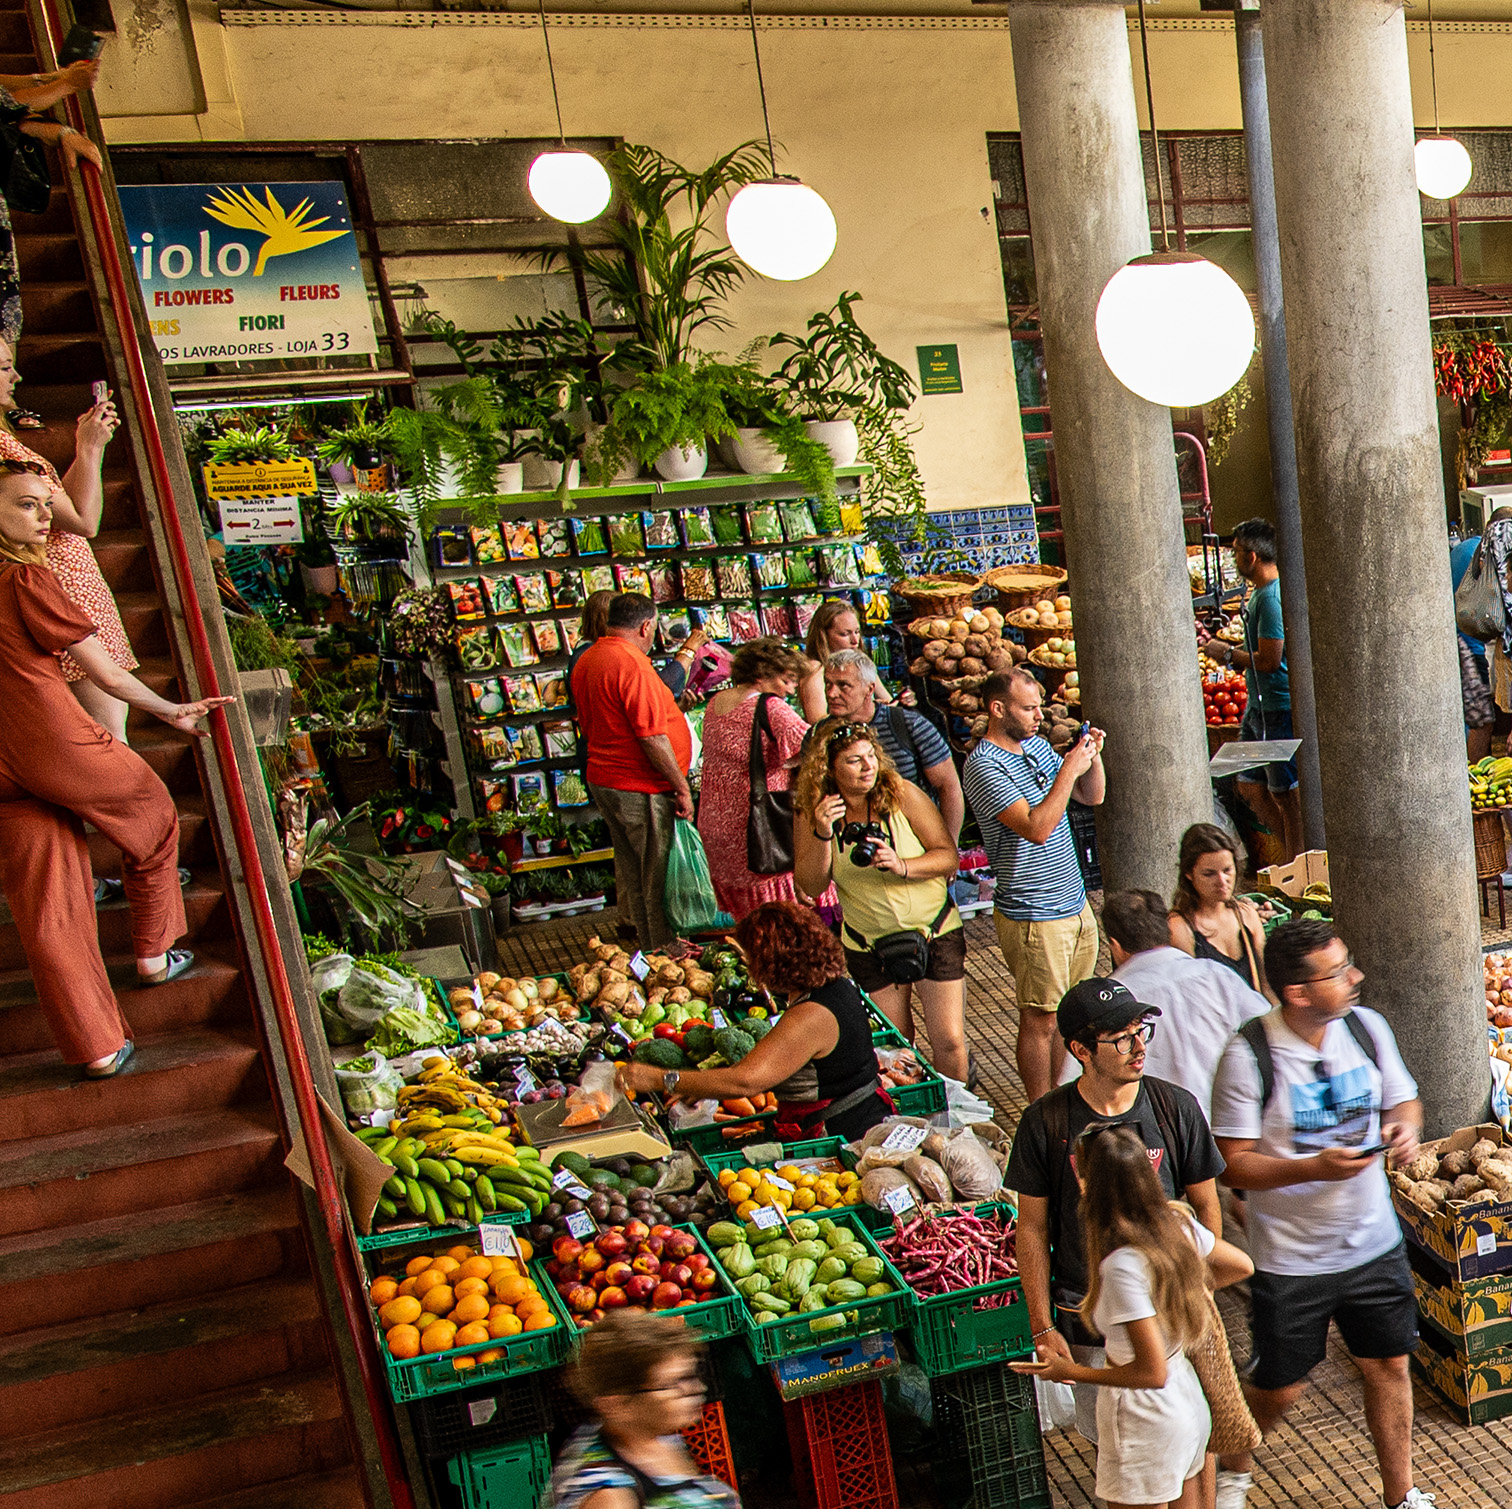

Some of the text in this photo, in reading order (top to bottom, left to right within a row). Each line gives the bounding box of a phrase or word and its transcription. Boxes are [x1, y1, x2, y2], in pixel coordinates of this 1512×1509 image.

[130, 230, 250, 280] iolo
[154, 284, 341, 307] FLOWERS FLEURS
[239, 315, 286, 331] FIORI
[183, 342, 274, 358] LAVRADORES
[287, 340, 318, 353] LOJA
[321, 332, 350, 351] 33
[212, 484, 251, 493] AGUARDE
[252, 483, 272, 491] AQUI
[280, 482, 296, 490] SUA
[298, 480, 313, 488] VEZ
[251, 518, 260, 530] 2
